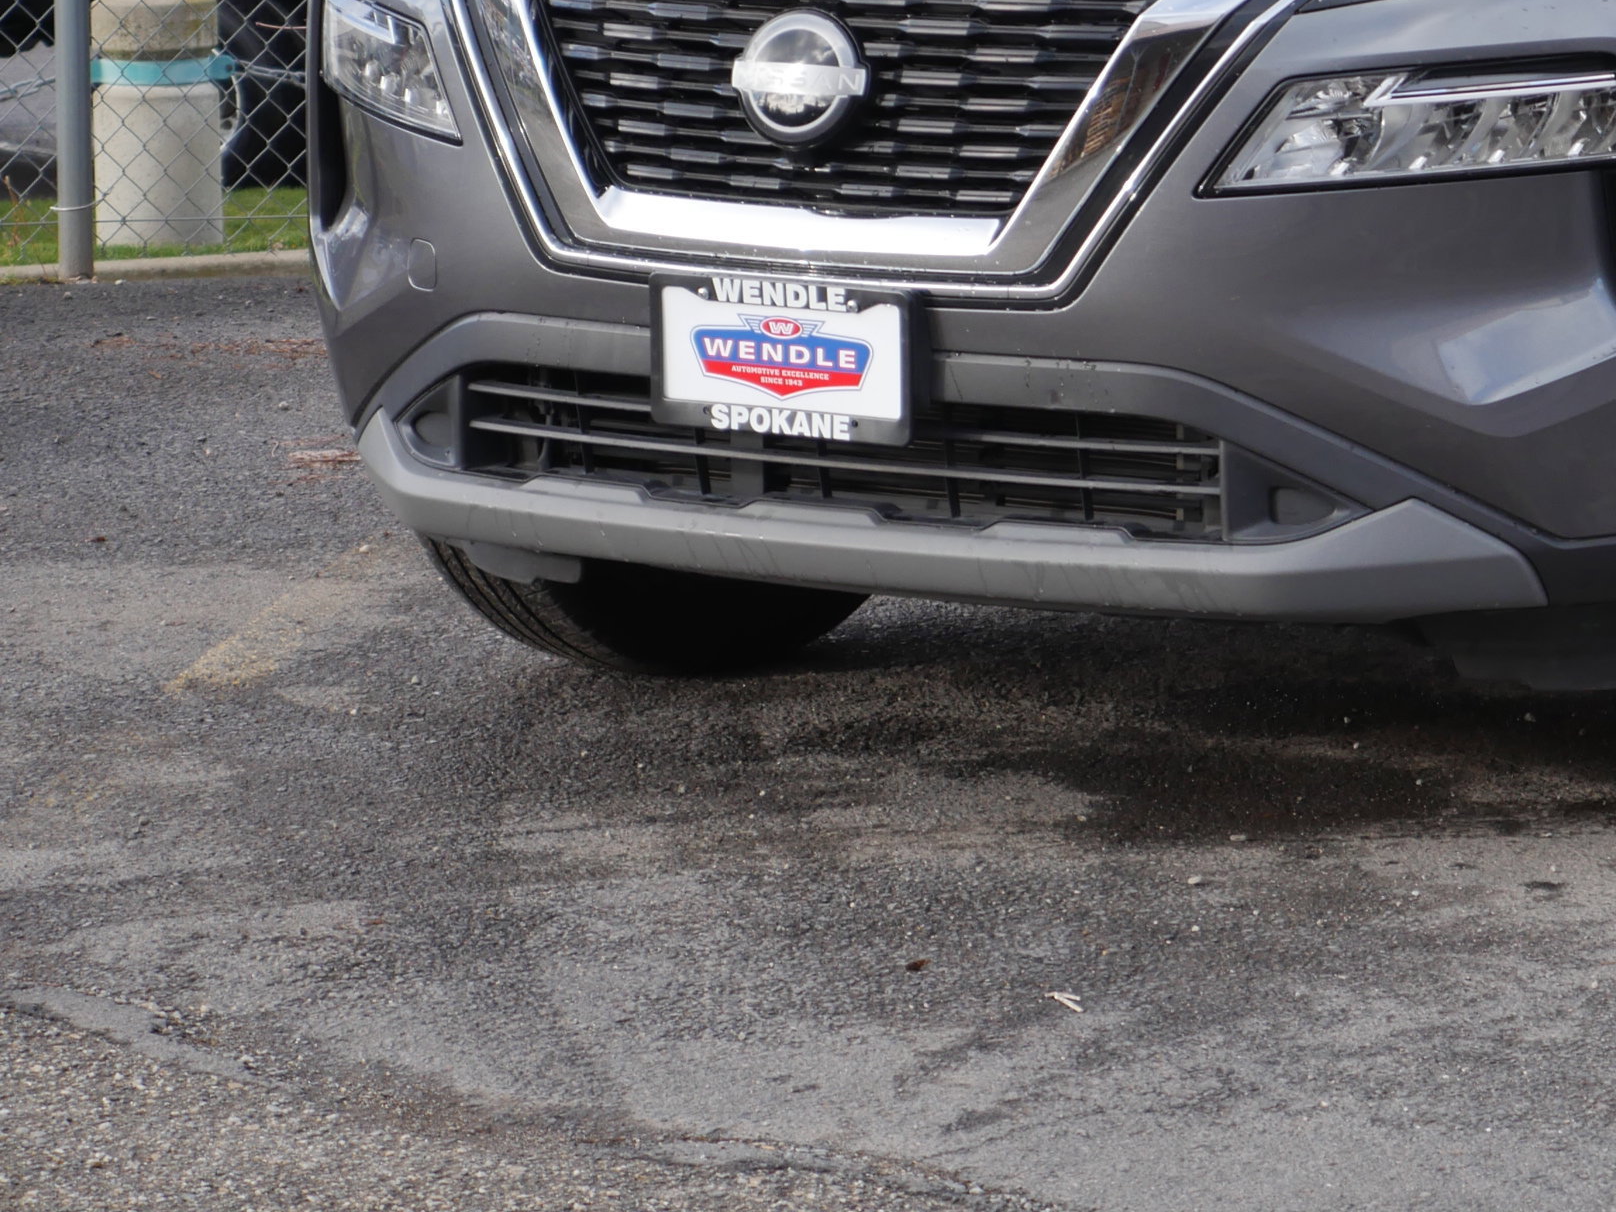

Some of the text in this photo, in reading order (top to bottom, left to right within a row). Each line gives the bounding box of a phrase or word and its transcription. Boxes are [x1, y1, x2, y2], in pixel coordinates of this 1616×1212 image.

[736, 64, 861, 92] SSAN
[712, 277, 847, 313] WENDLE
[703, 337, 856, 369] WENDLE
[731, 364, 829, 381] AUTOMOTIVE EXCELLENCE
[760, 376, 783, 385] SINCE
[711, 404, 850, 441] SPOKANE
